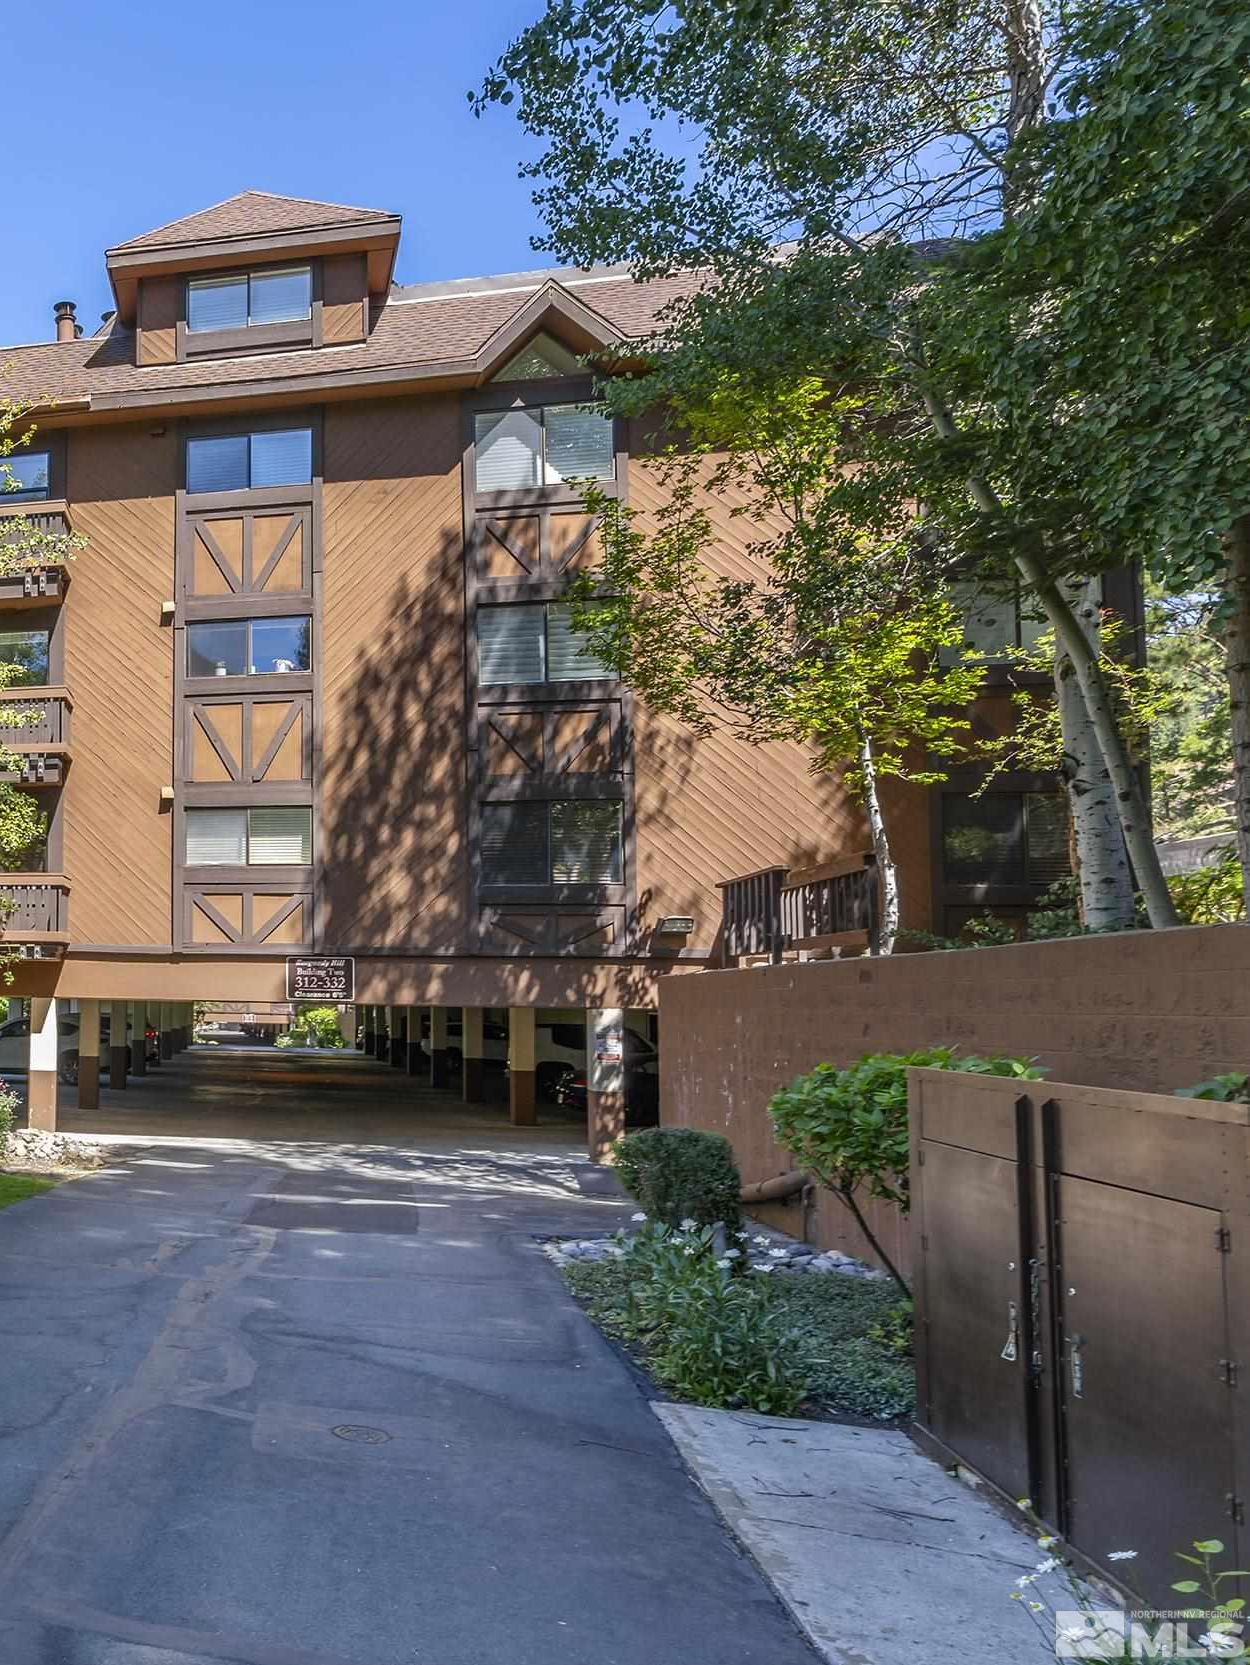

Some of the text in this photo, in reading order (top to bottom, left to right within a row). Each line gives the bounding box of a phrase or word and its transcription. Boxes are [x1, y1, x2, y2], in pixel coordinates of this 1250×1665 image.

[296, 967, 345, 977] Building Two
[295, 976, 346, 988] 312-332
